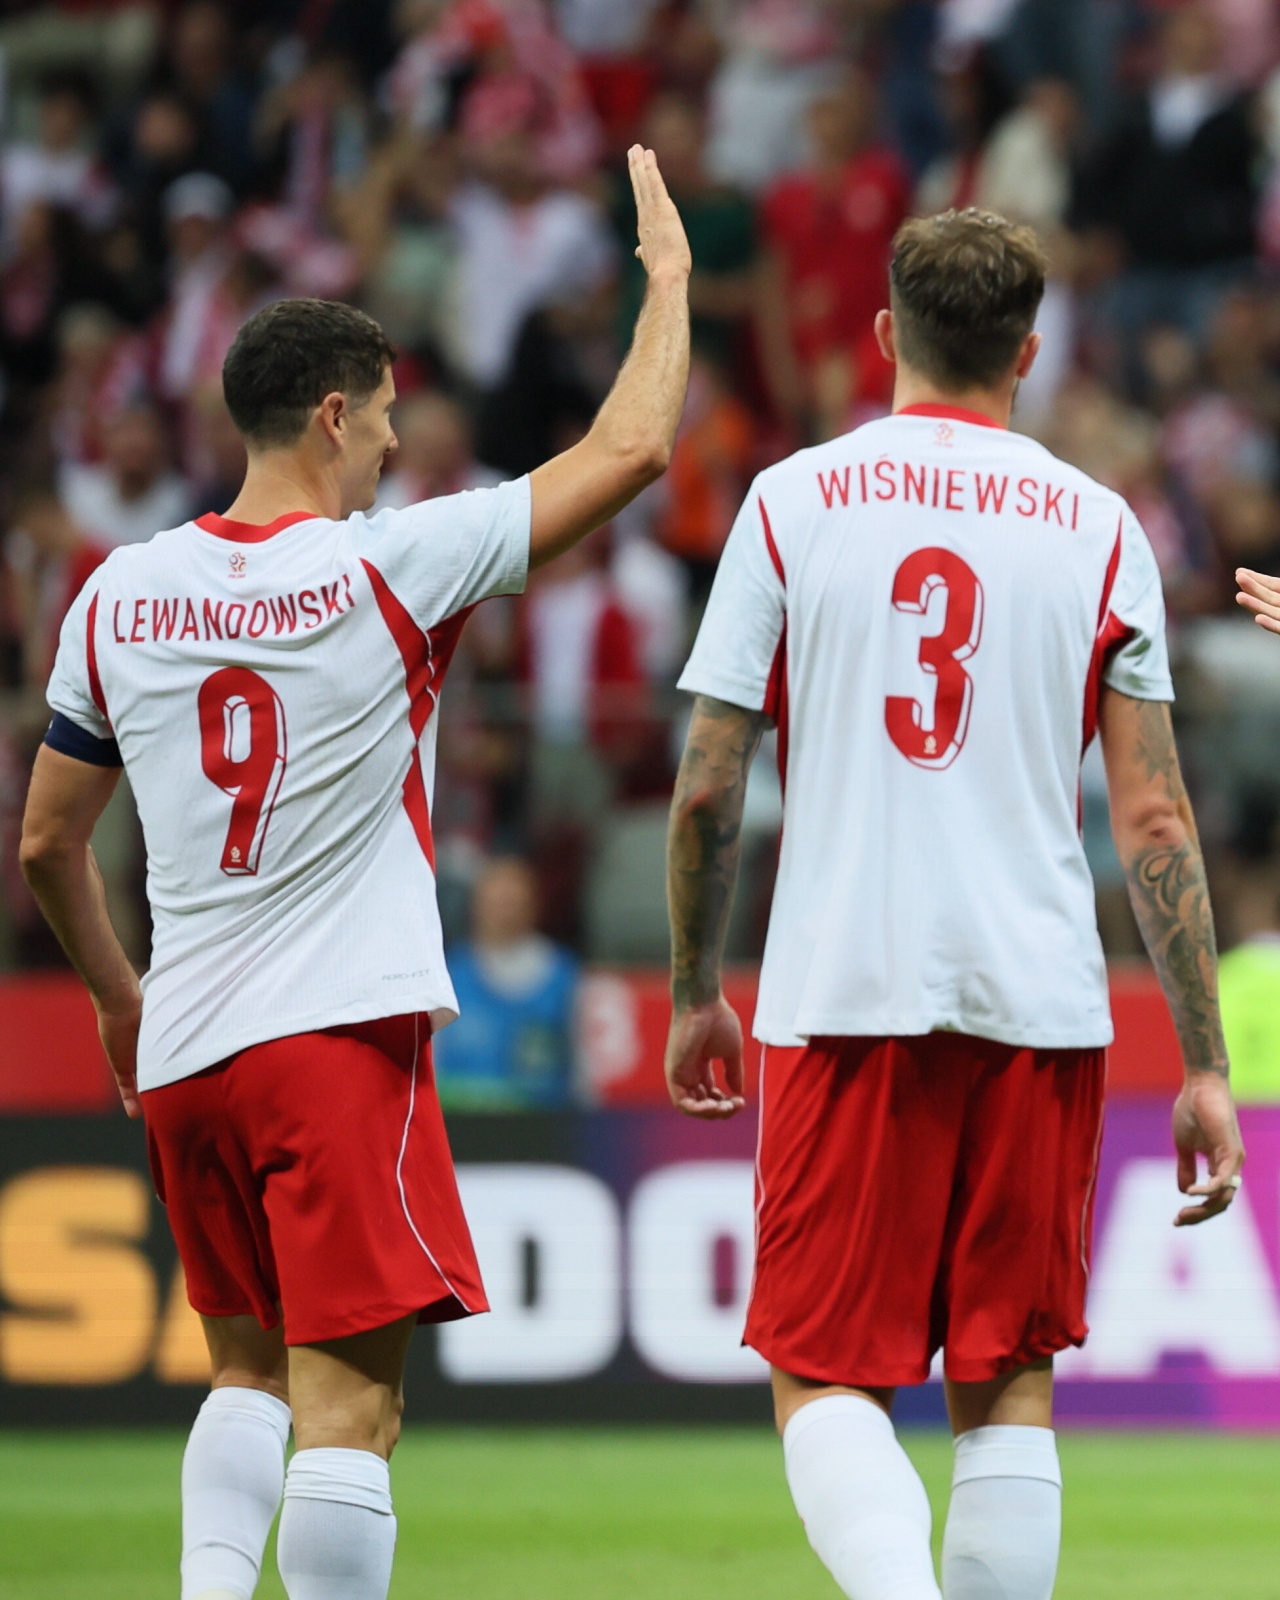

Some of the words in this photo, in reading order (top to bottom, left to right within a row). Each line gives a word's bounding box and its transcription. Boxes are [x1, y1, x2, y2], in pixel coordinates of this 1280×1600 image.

[817, 454, 1079, 531] WIŚNIEWSKI
[113, 574, 355, 643] LEWANDOWSKI
[885, 546, 984, 771] 3
[197, 666, 287, 876] 9
